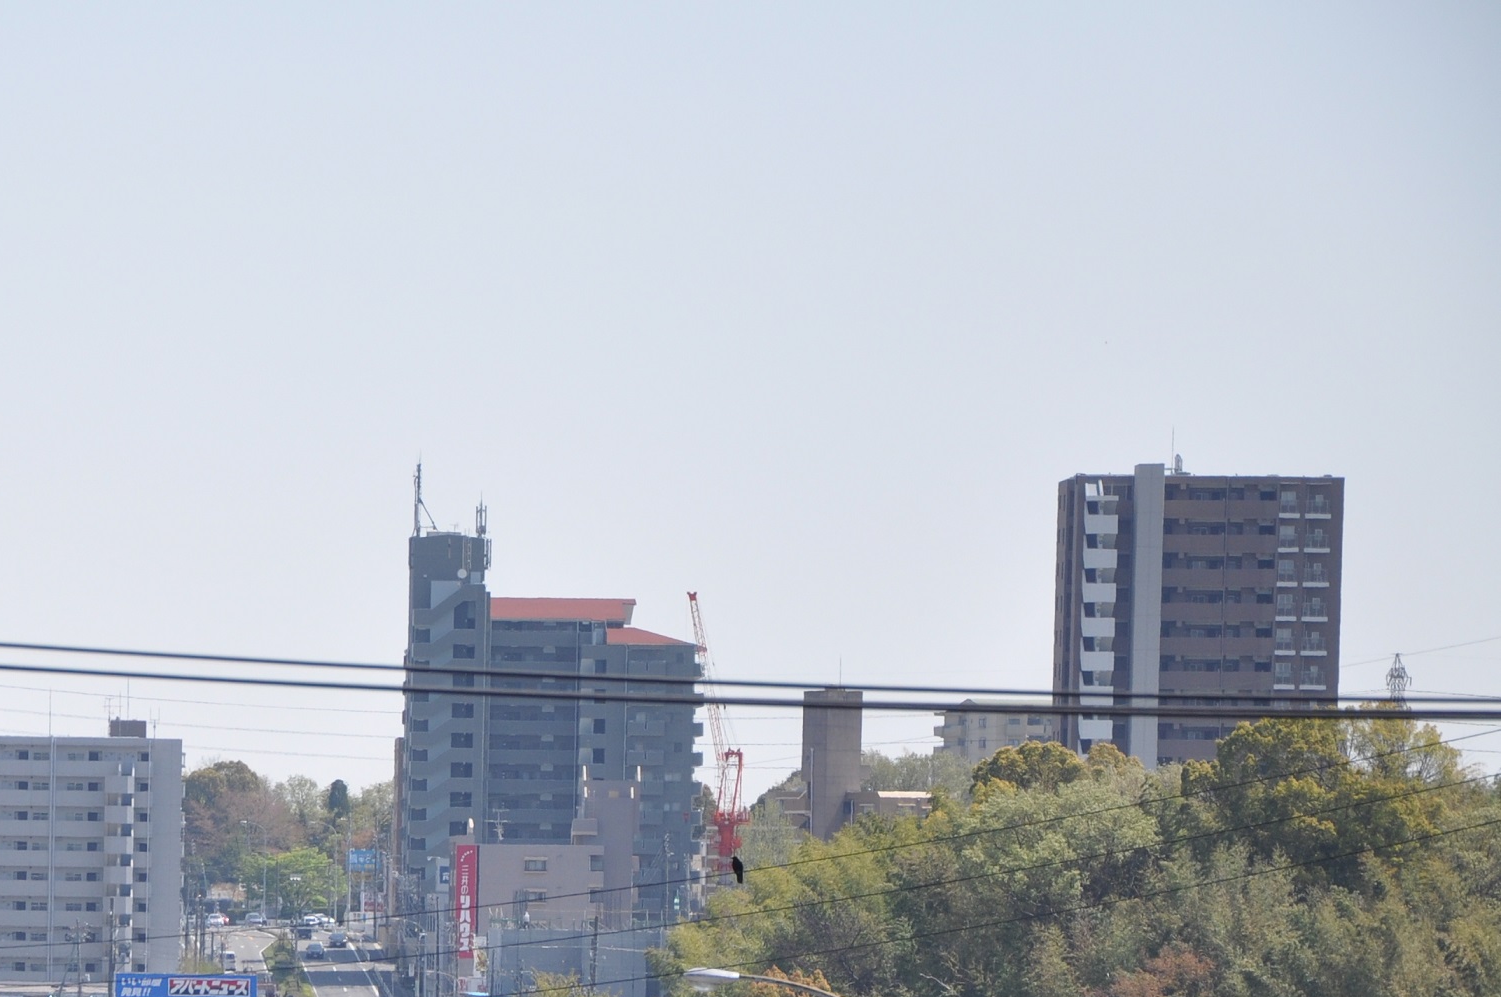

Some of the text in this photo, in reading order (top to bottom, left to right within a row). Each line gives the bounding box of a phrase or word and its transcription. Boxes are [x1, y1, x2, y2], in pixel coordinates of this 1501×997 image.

[170, 979, 249, 996] アパートニュース
